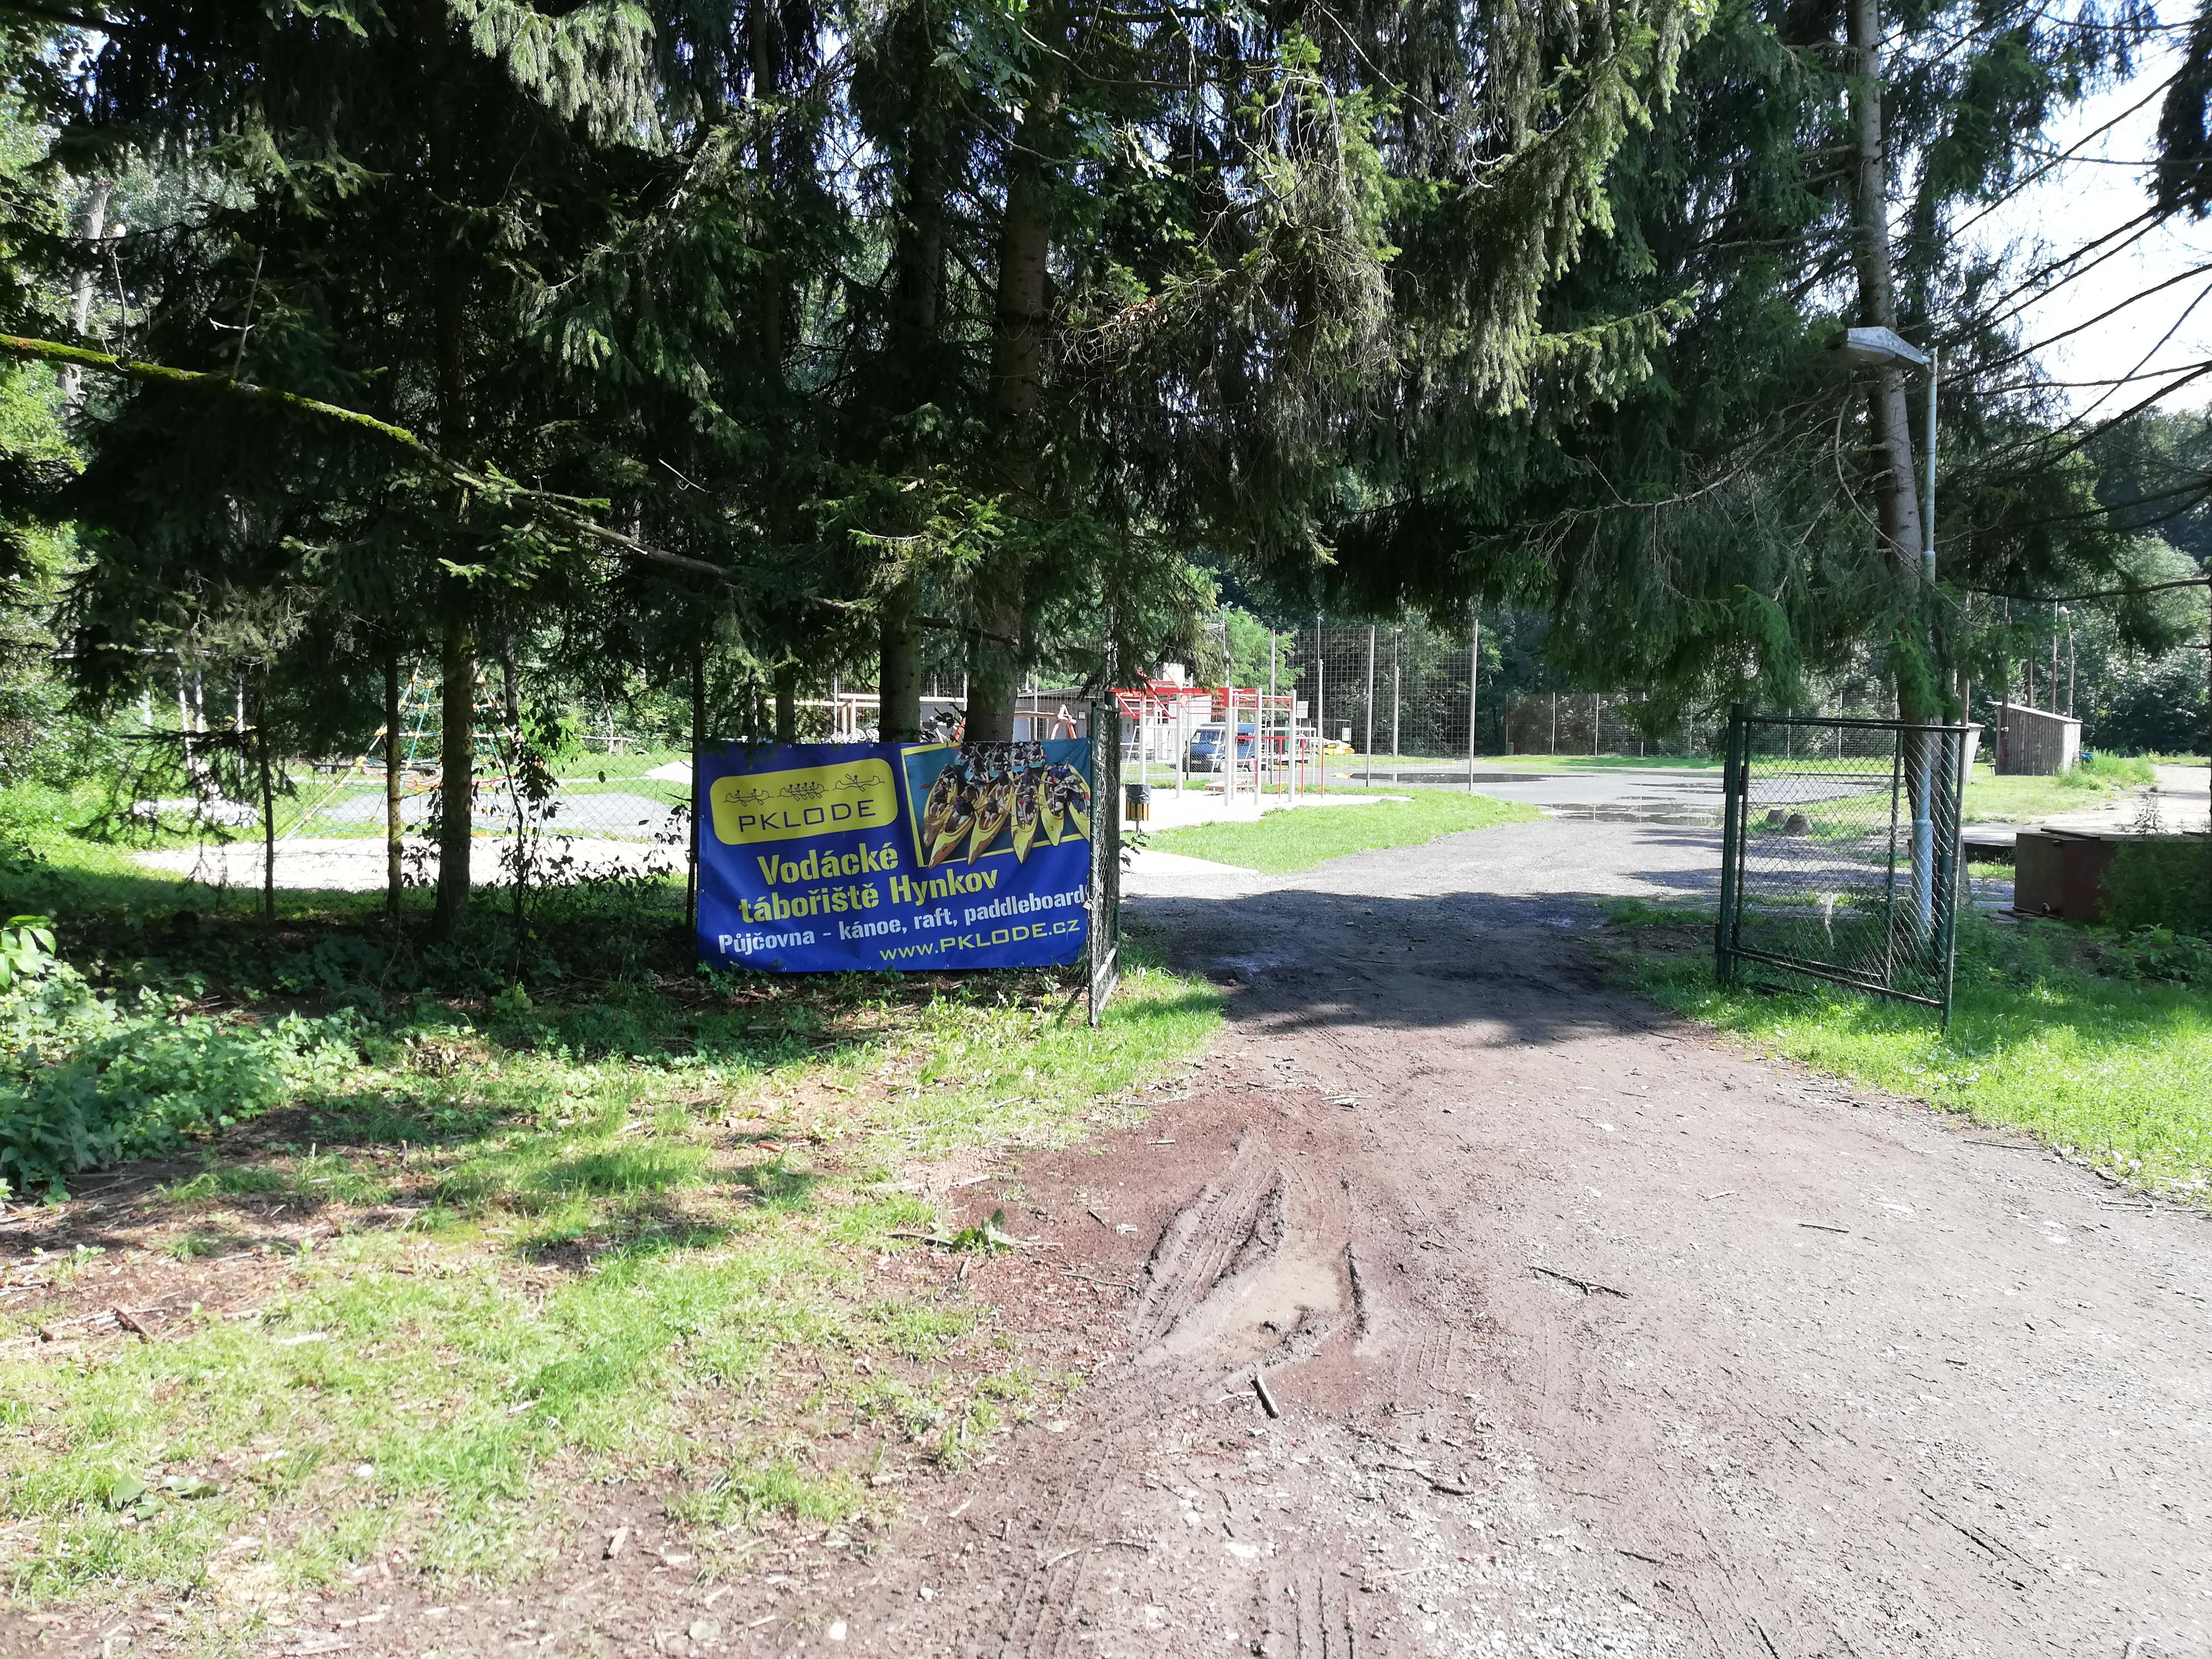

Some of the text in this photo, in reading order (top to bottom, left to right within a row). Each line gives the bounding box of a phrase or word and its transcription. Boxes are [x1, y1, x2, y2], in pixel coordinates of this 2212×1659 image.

[739, 800, 876, 832] PKLODE
[758, 842, 899, 885] Vodácké
[739, 869, 998, 924] tábořiště Hynkov
[719, 931, 815, 956] Půjčovna
[839, 919, 907, 940] kánoe,
[914, 907, 958, 930] raft,
[965, 884, 1085, 925] paddleboard
[879, 919, 1080, 961] www.PKLODE.cz
